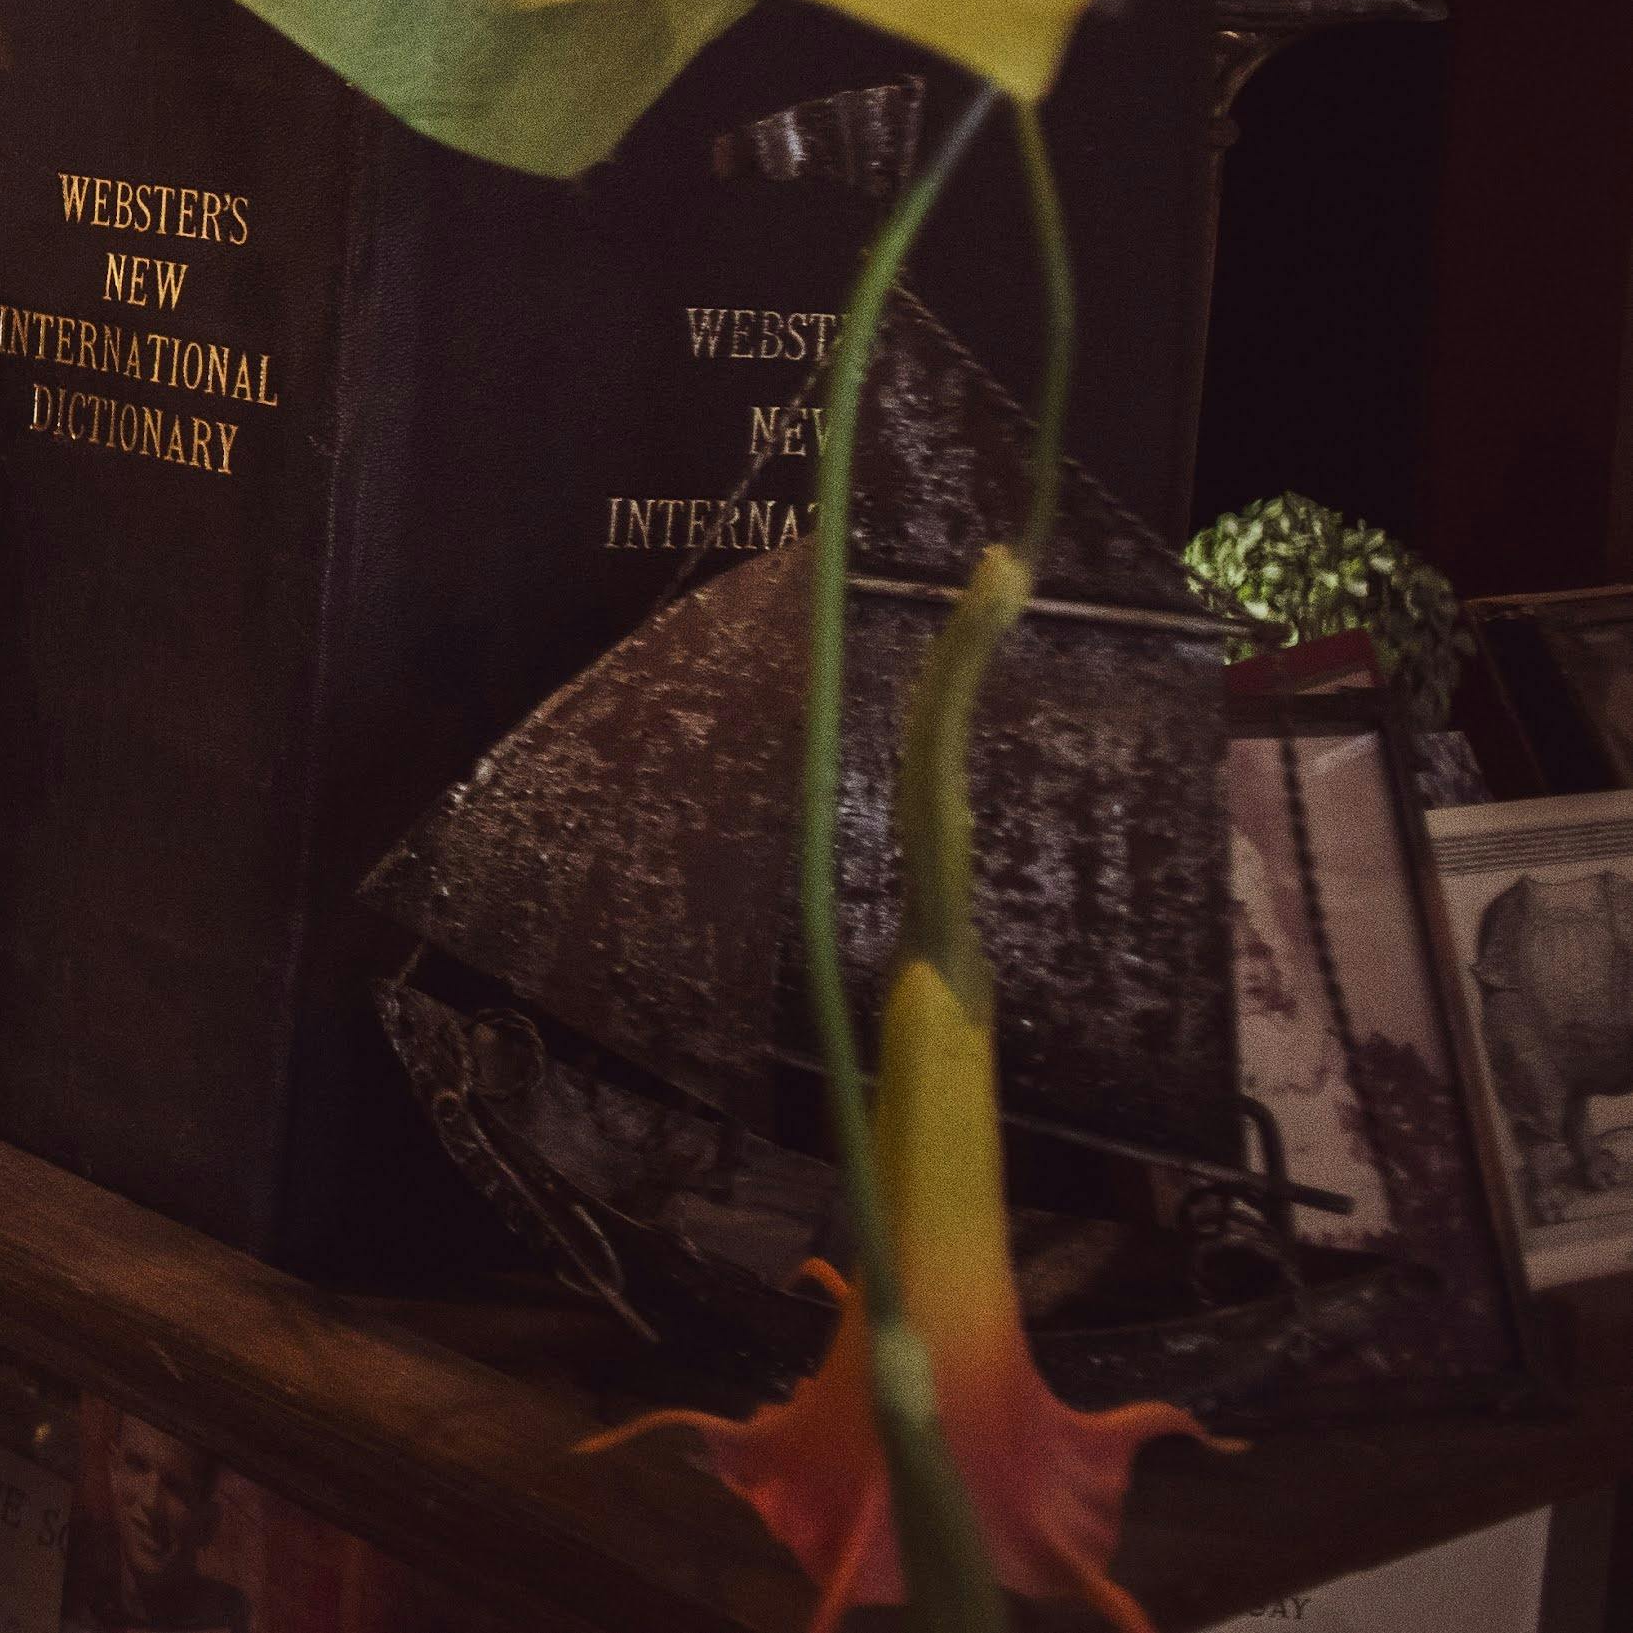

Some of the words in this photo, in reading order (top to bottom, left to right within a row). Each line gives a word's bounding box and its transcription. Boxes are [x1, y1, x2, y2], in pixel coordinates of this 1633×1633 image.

[58, 171, 250, 246] WEBSTER'S
[103, 252, 189, 311] NEW
[685, 307, 837, 362] WEBST
[29, 382, 239, 475] DICTIONARY
[605, 497, 820, 551] INTERNA
[1250, 1597, 1311, 1620] AY
